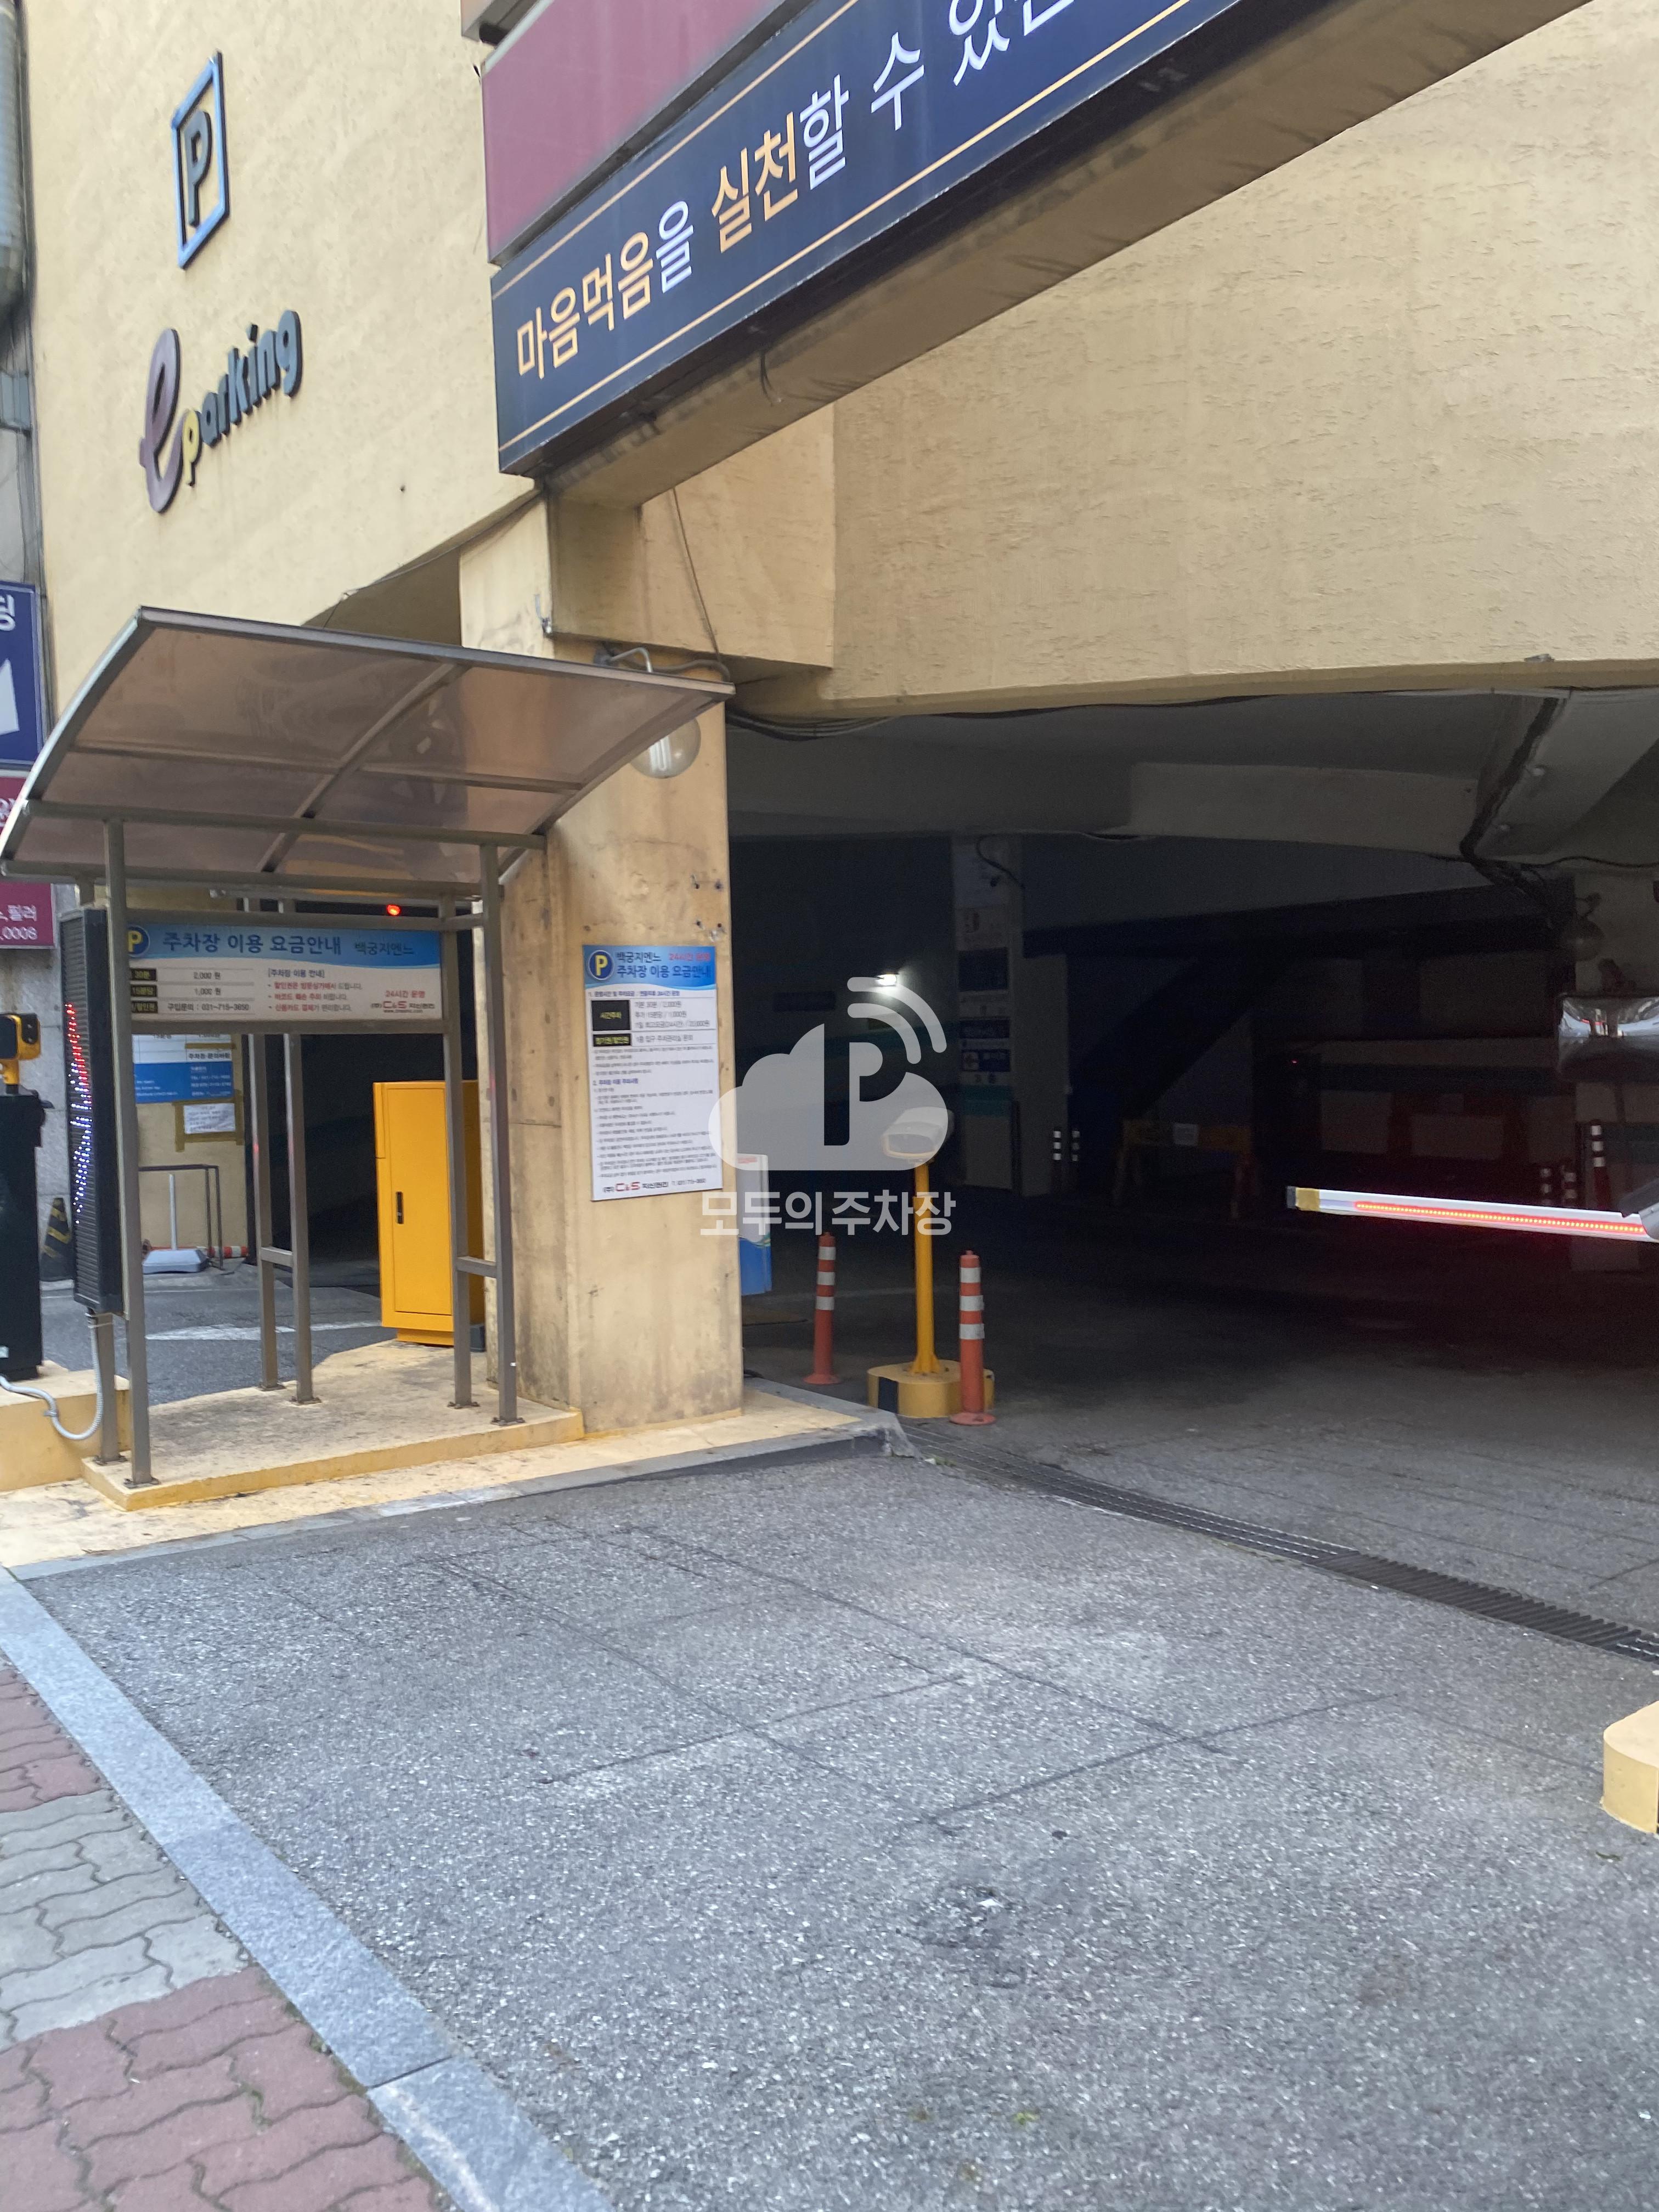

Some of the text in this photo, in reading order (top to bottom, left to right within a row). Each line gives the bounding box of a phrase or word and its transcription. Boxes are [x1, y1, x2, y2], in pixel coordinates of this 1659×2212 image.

[517, 199, 695, 380] 마음먹음을
[711, 74, 850, 254] 실천할
[871, 32, 925, 131] 수
[163, 932, 220, 953] 주차장
[228, 934, 263, 953] 이용
[269, 935, 341, 955] 요금안내
[617, 965, 712, 978] 주차장 이용 요금안내
